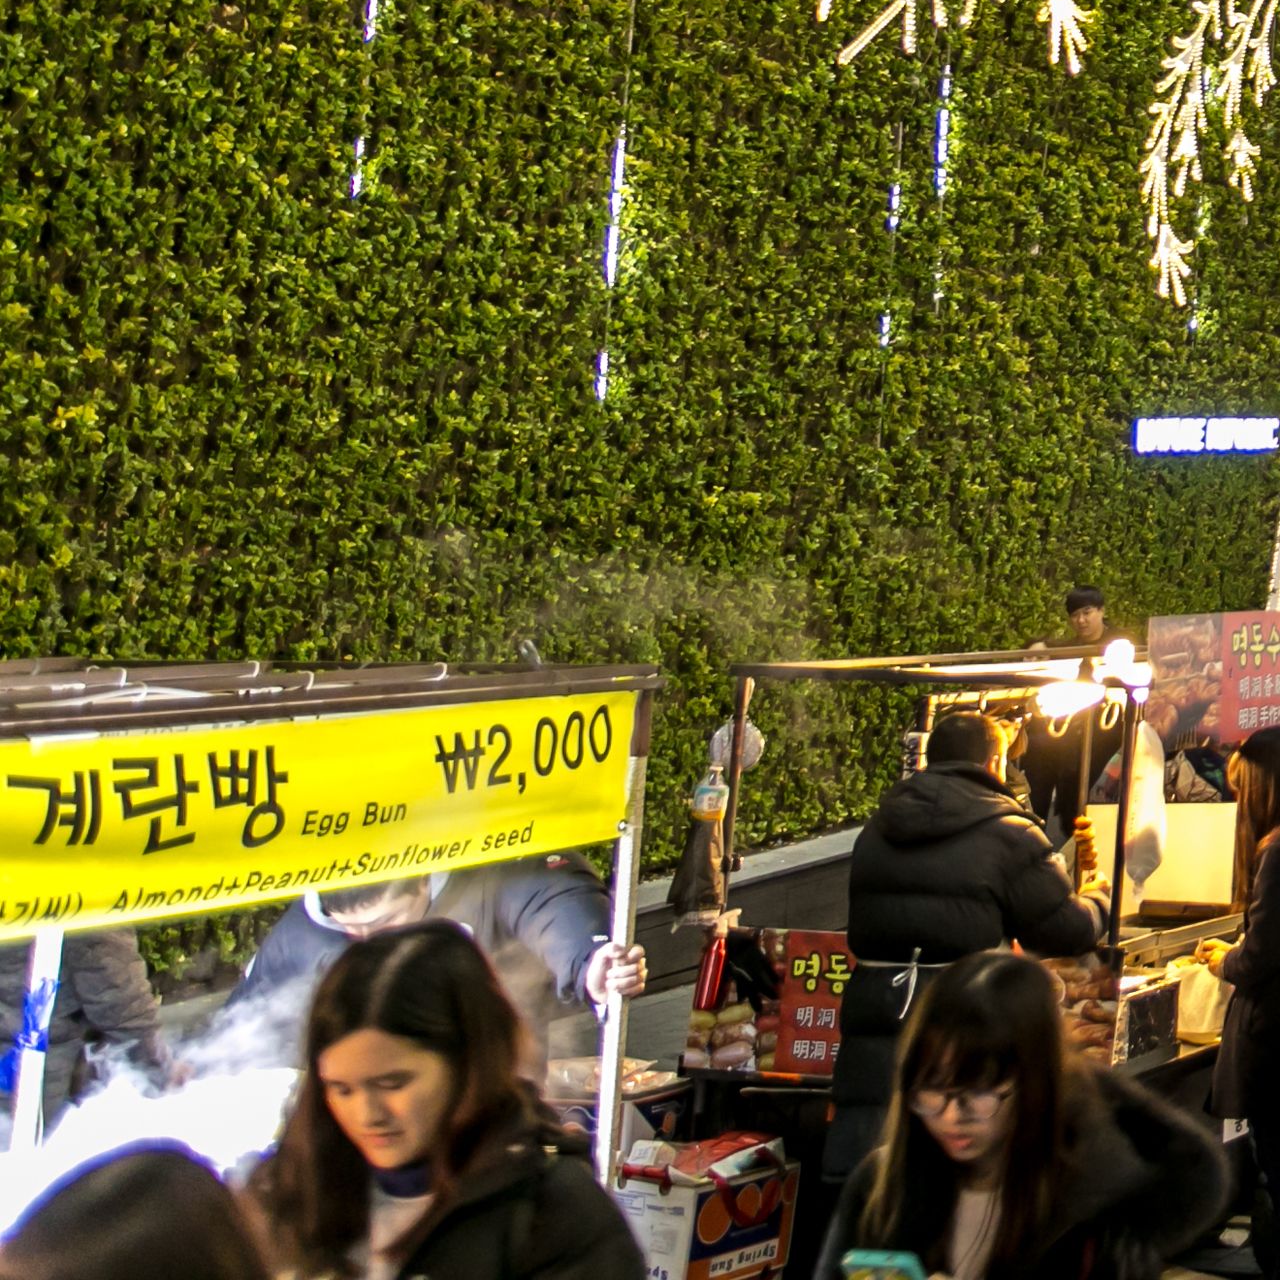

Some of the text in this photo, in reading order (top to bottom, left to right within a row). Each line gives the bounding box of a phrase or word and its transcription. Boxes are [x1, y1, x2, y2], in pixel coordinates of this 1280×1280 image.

[7, 704, 613, 855] 계란빵 ₩2,000
[301, 801, 408, 836] Egg Bun
[107, 837, 473, 915] Almond+Peanut+Sunflower
[482, 821, 535, 852] seed
[793, 952, 852, 995] 명동
[796, 1006, 836, 1029] 明洞
[711, 1243, 776, 1274] Spring Sun
